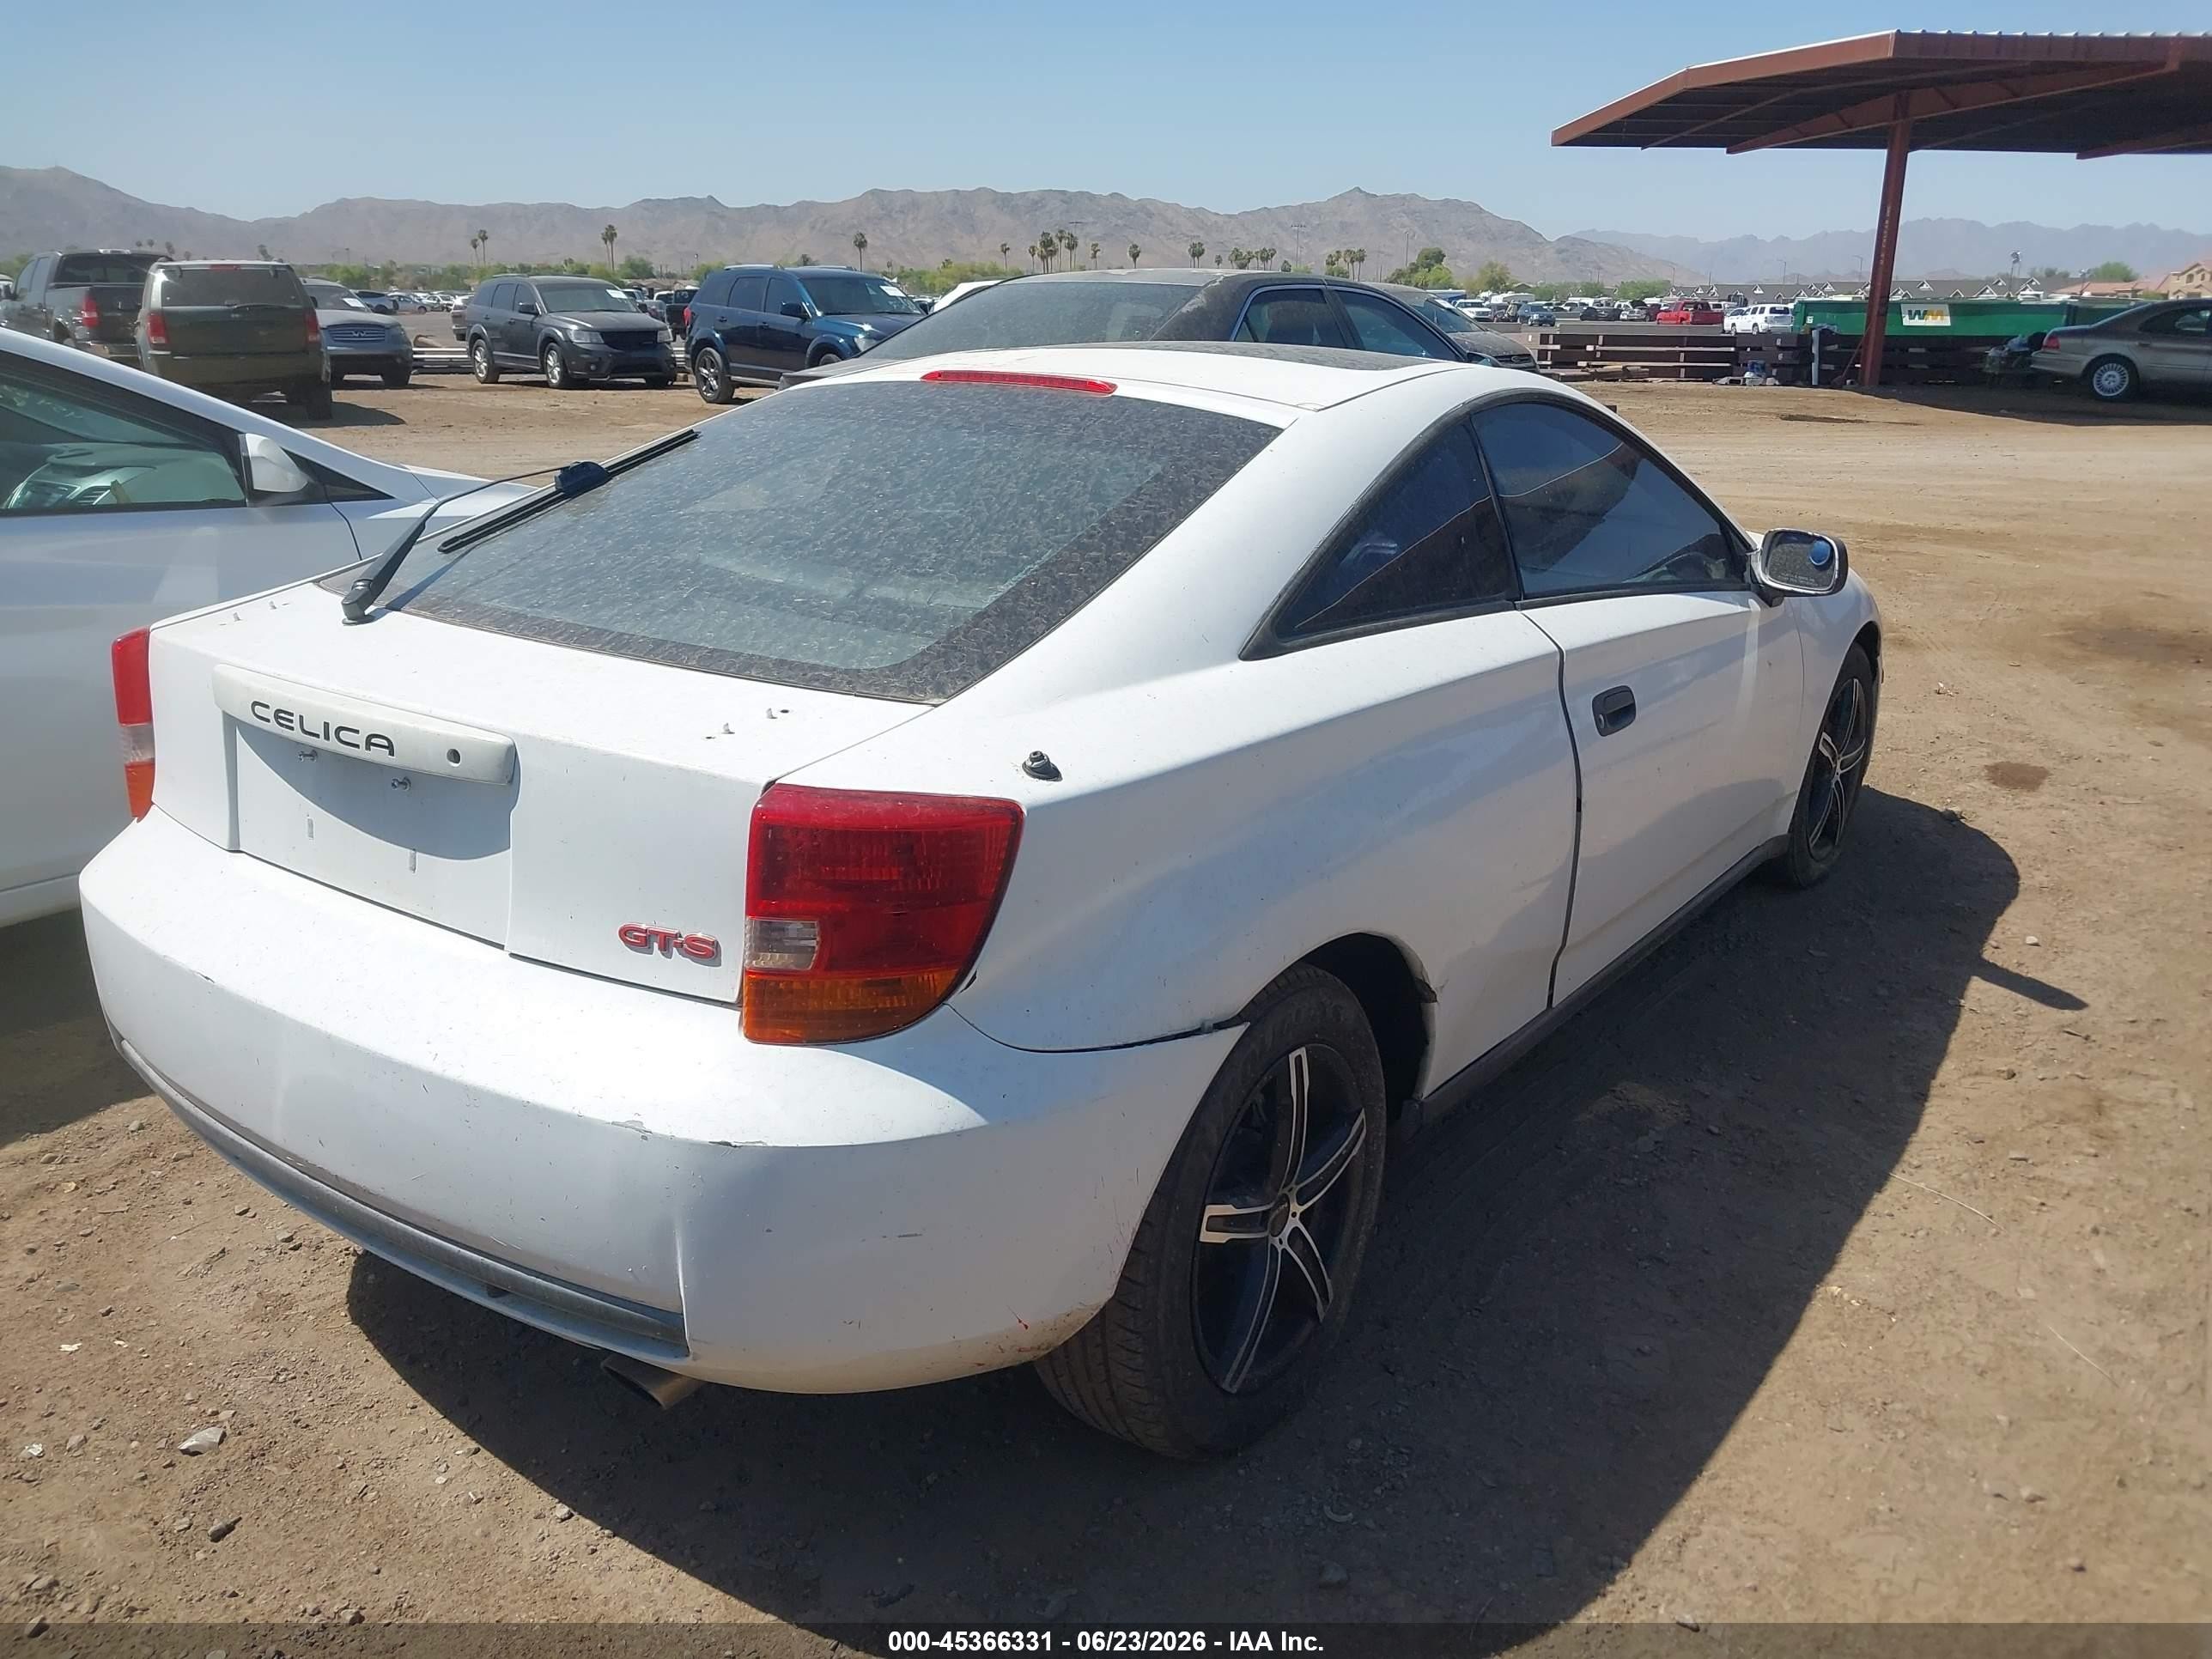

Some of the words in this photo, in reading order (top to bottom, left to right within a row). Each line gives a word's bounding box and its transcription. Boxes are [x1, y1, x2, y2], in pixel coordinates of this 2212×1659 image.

[1907, 307, 1945, 321] WM
[251, 700, 394, 757] CELICA
[618, 923, 717, 960] GT-S
